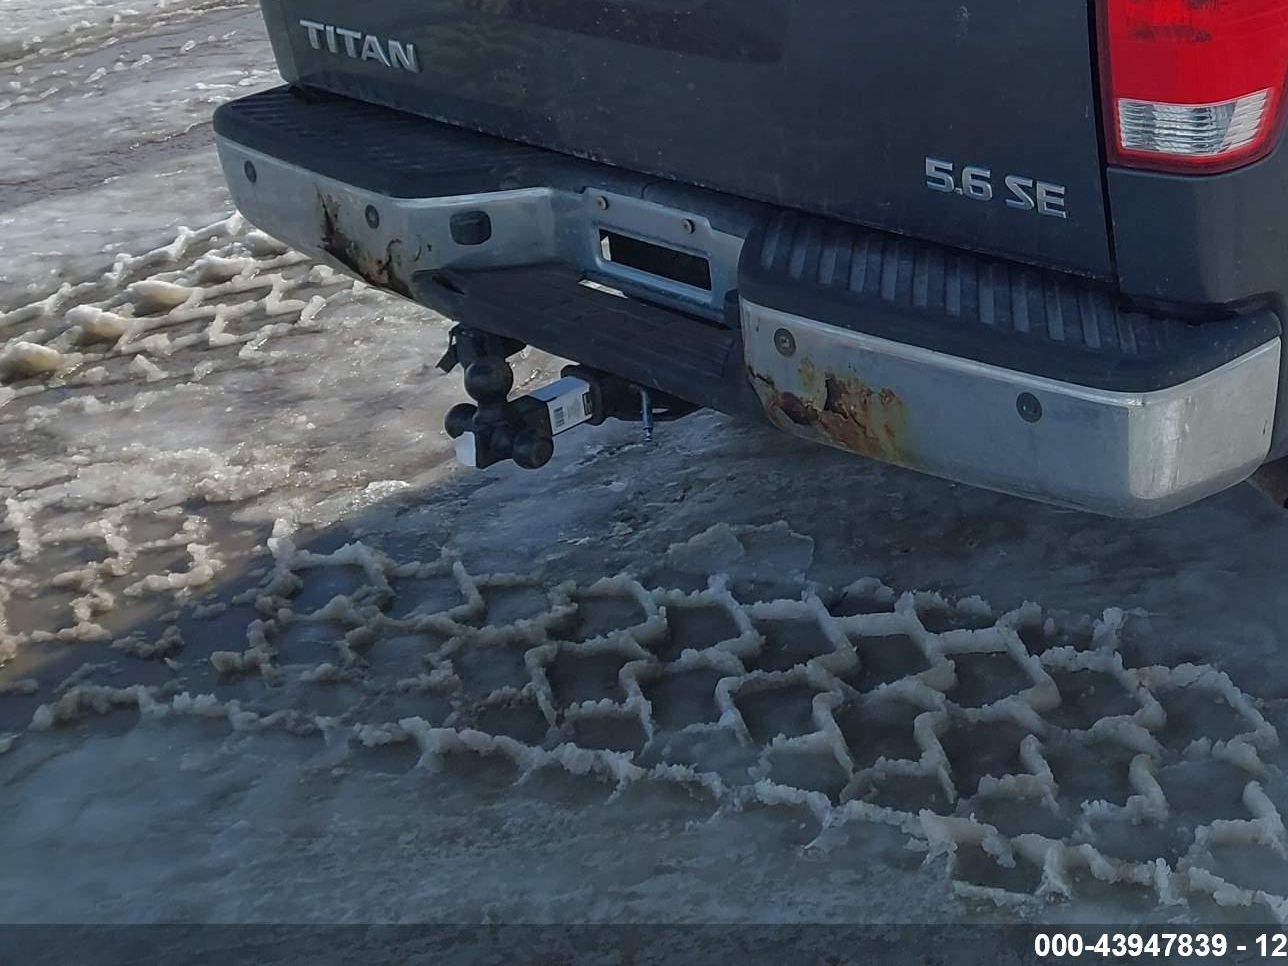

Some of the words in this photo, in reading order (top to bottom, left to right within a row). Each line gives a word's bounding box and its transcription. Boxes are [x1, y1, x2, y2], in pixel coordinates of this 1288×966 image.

[300, 19, 419, 73] TITAN
[925, 156, 993, 201] 5.6
[1004, 175, 1067, 219] SE
